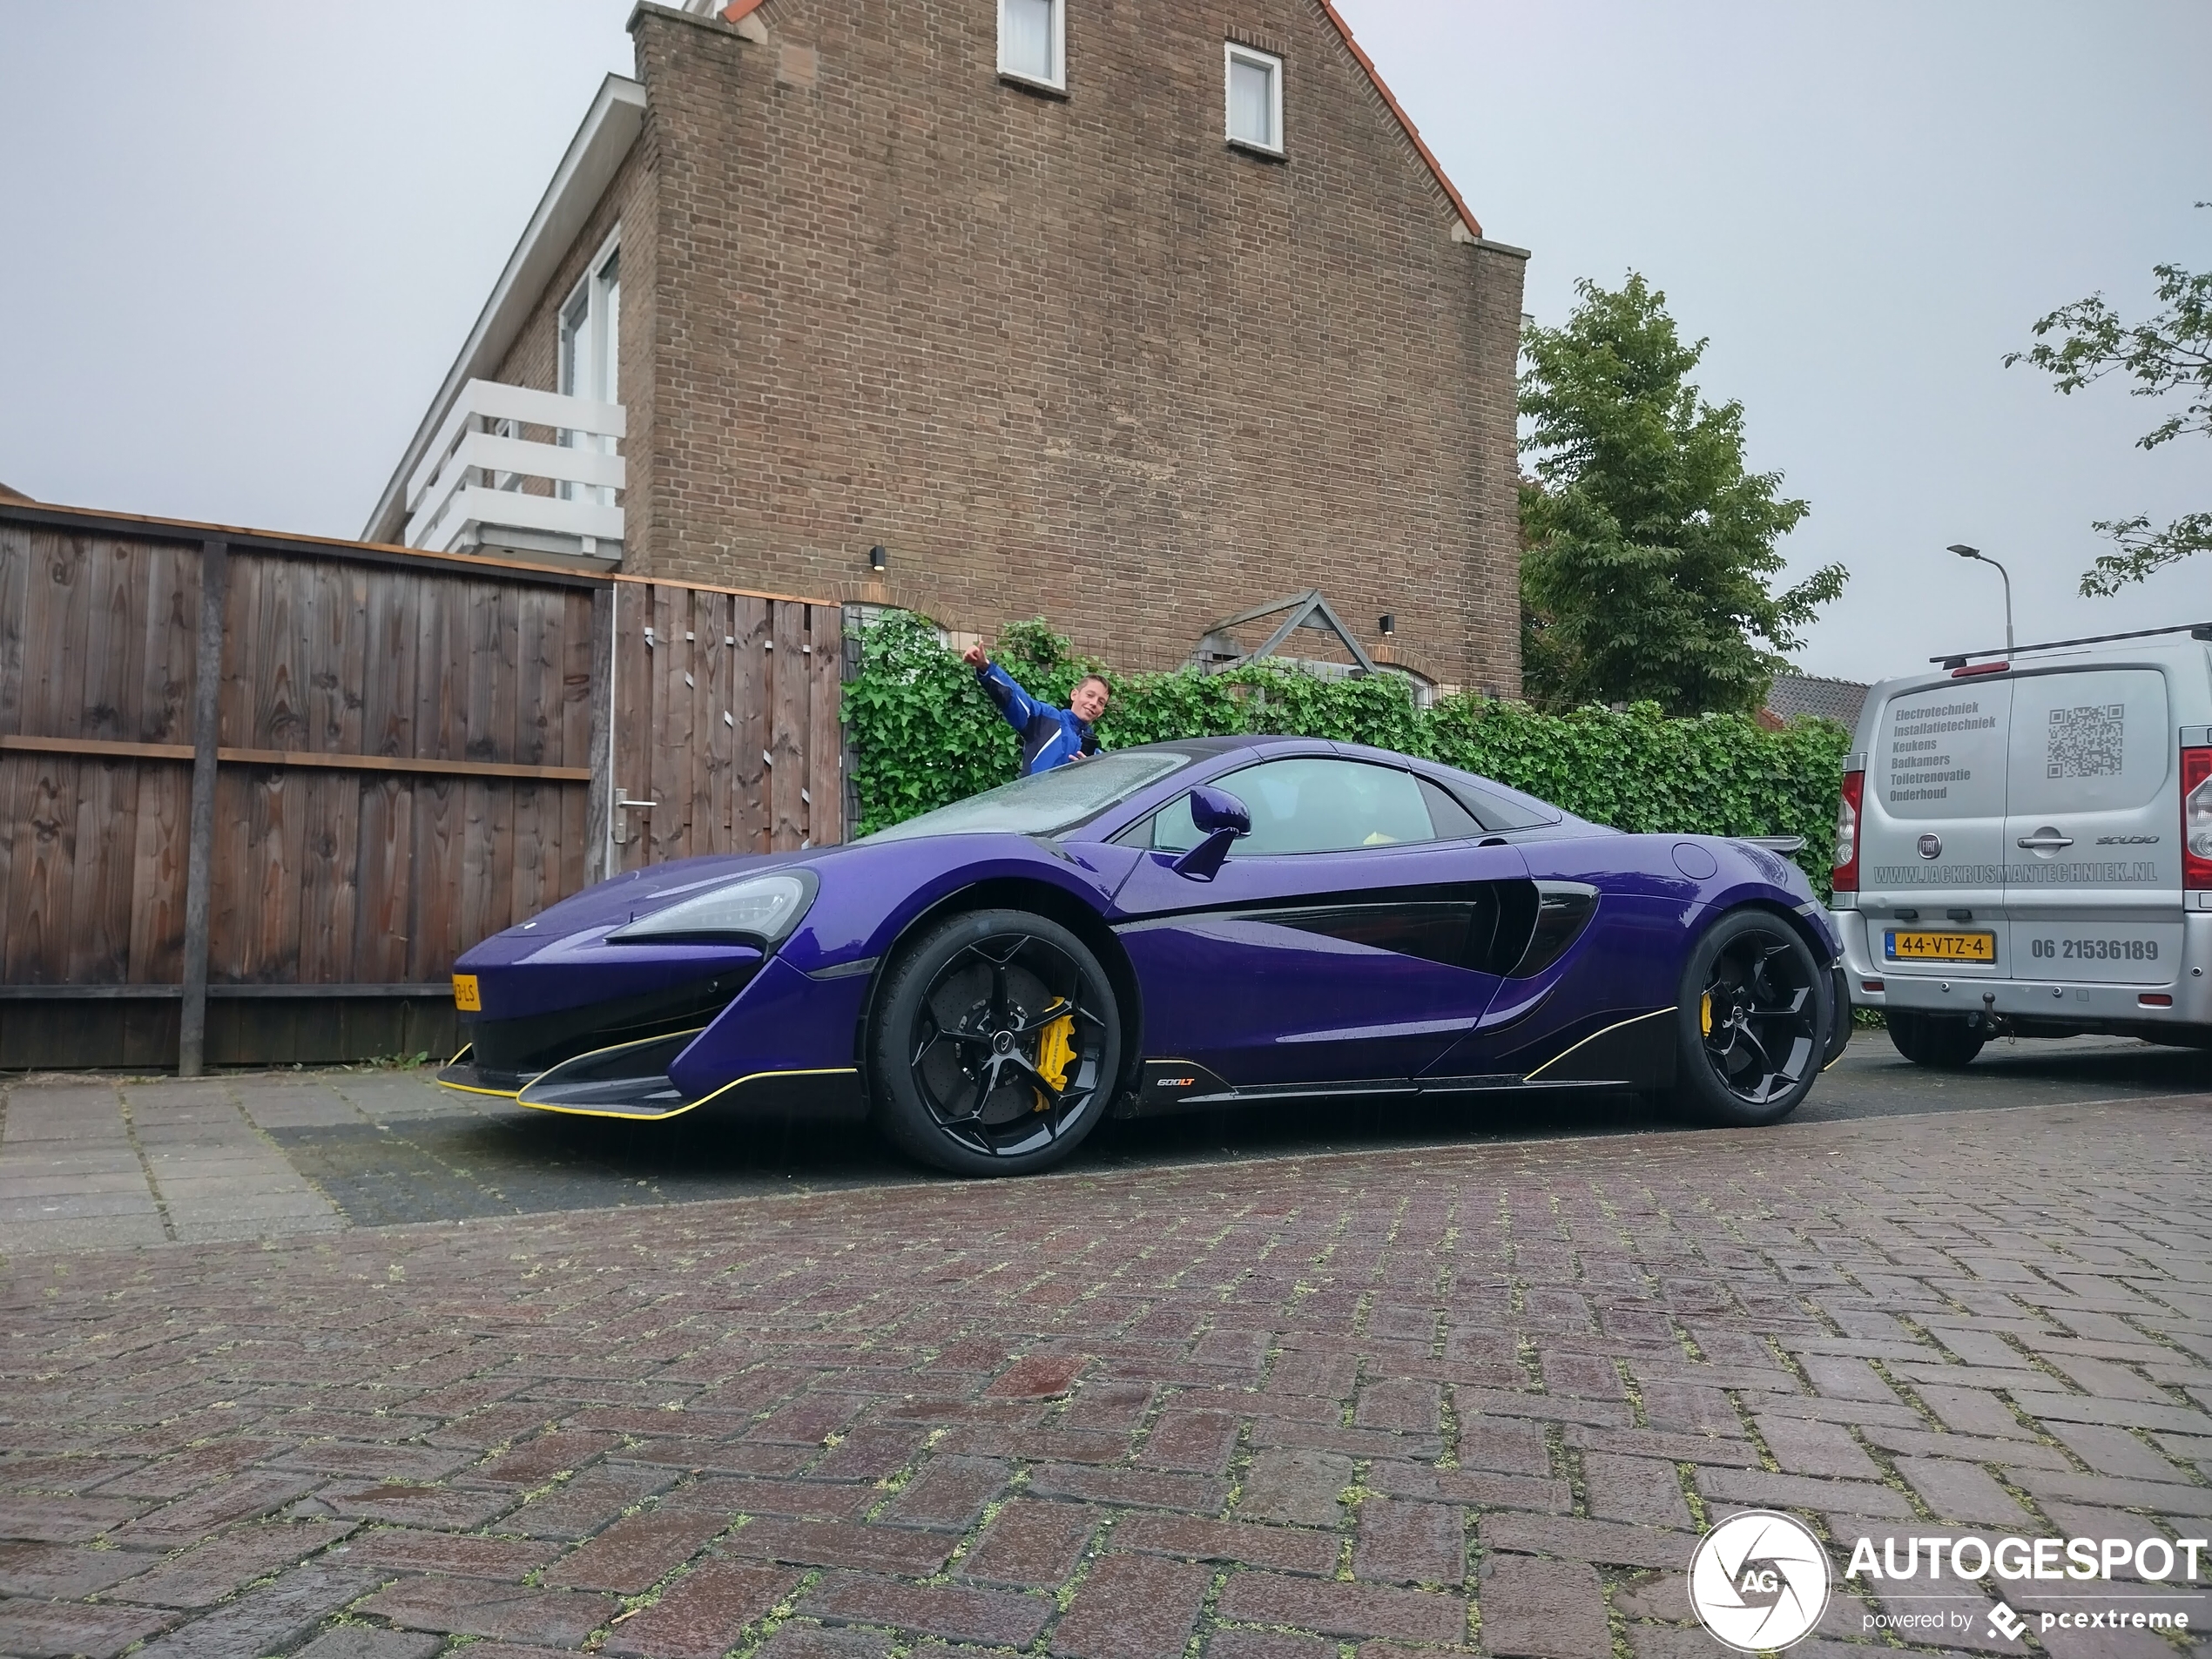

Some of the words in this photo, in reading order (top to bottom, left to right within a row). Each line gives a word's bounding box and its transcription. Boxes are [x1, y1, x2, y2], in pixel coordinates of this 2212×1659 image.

[1895, 701, 1979, 721] Electrotechniek
[1893, 716, 1996, 738] Installatietechniek
[1892, 738, 1938, 753] Keukens
[1892, 753, 1951, 770] Badkamers
[1891, 769, 1971, 786] Toiletrenovatie
[1890, 786, 1947, 802] Onderhoud
[1922, 840, 1936, 853] FIAT
[2095, 834, 2160, 846] SCUDO
[1873, 861, 2158, 884] WWW.JACKRUSMANTECHNIEK.NL
[1902, 936, 1984, 955] 44-VTZ-4
[2032, 939, 2055, 958] 06
[2062, 939, 2158, 961] 21536189
[1157, 1078, 1195, 1087] 600LT
